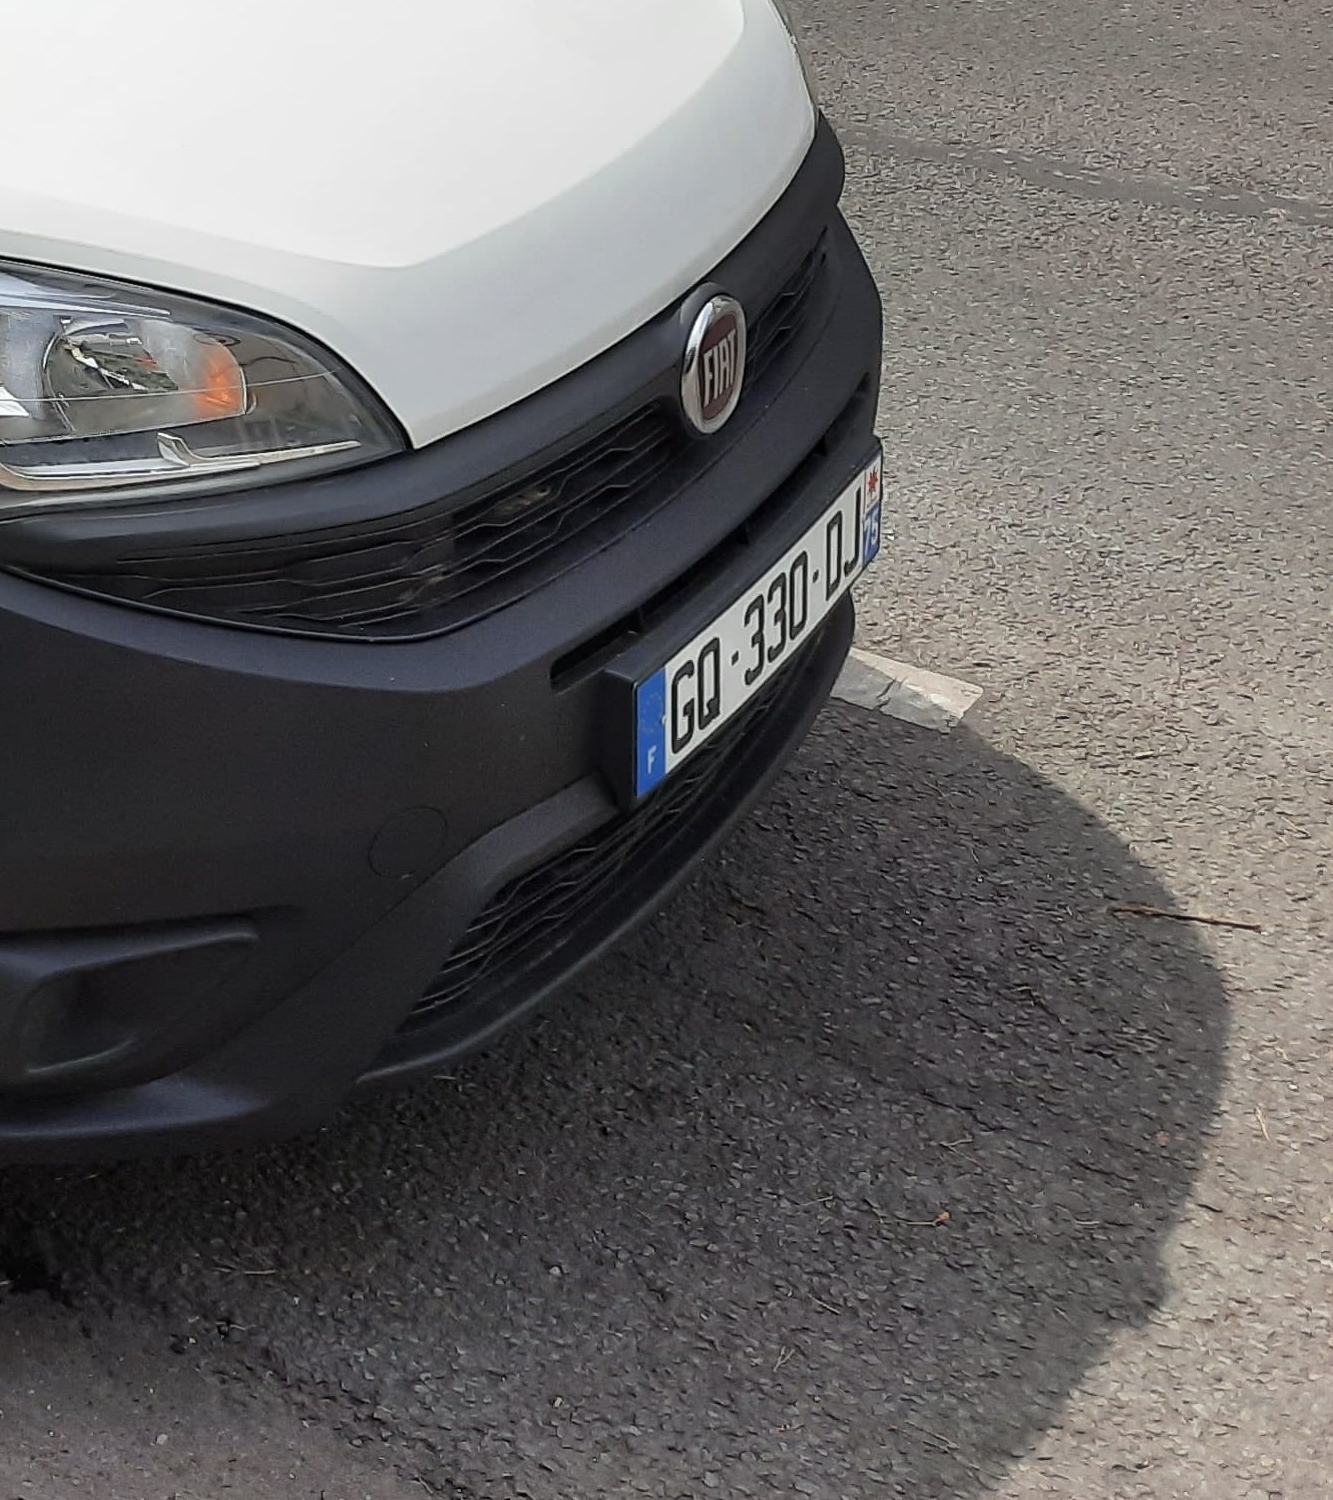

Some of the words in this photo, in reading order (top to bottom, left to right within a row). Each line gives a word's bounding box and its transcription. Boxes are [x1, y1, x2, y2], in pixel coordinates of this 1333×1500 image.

[703, 328, 736, 407] FIAT
[864, 506, 880, 558] 75
[647, 744, 657, 775] F
